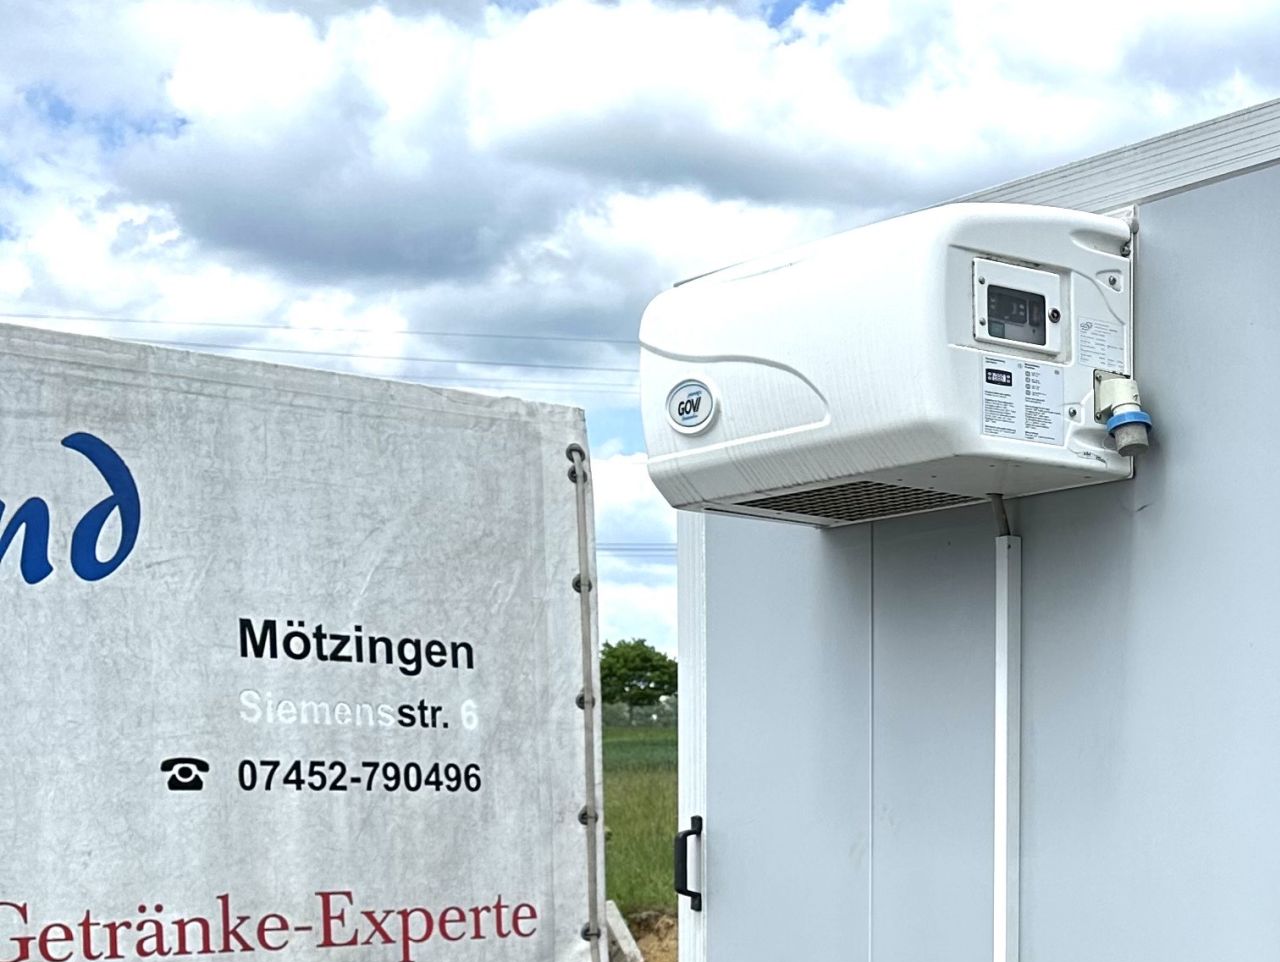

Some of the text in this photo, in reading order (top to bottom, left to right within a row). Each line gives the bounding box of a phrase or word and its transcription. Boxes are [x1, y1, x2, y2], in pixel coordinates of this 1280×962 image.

[239, 618, 475, 676] Mötzingen
[240, 689, 479, 731] Siemensstr. 6
[239, 759, 481, 793] 07452-790496
